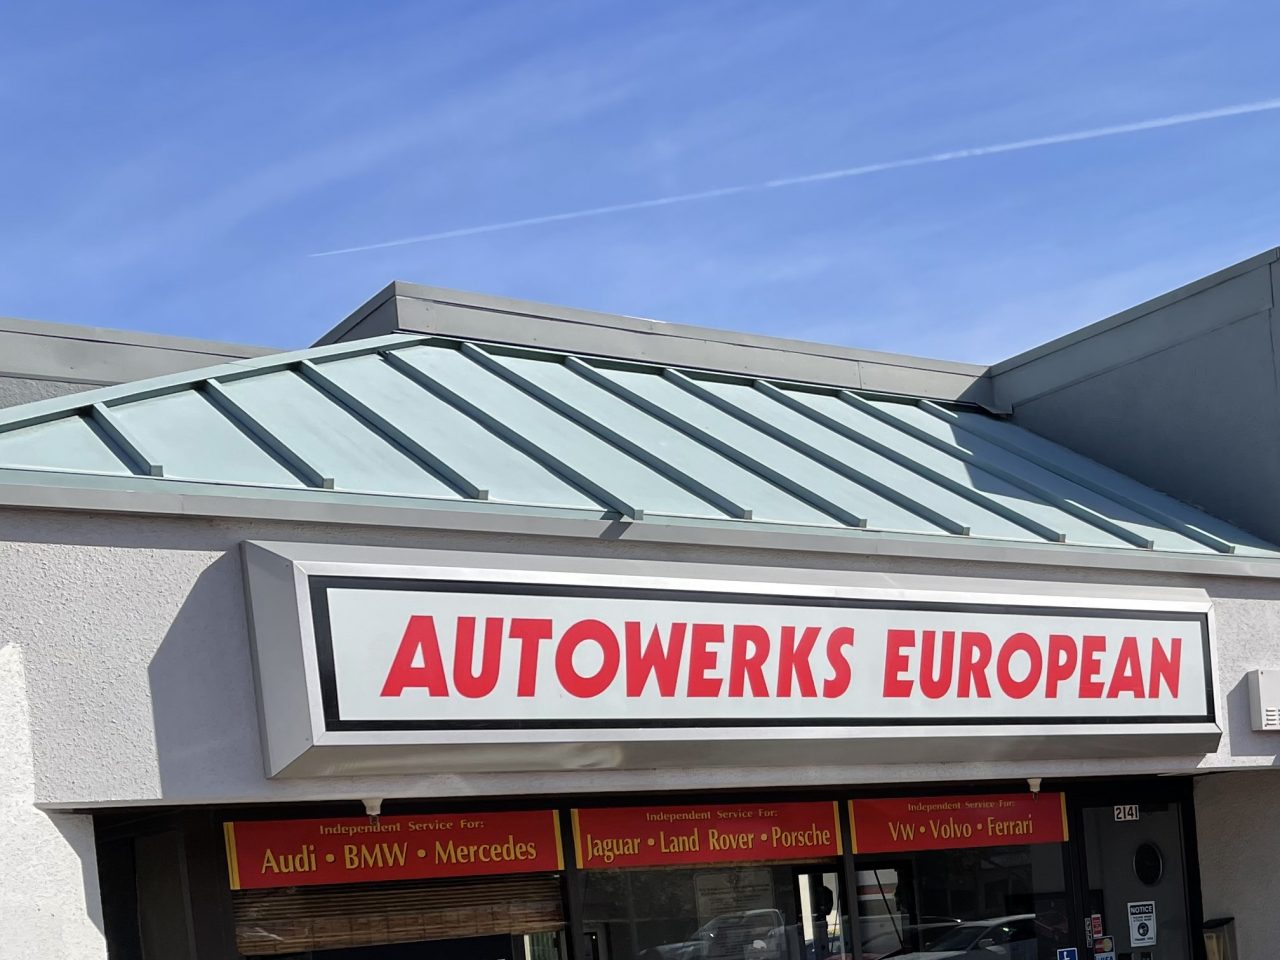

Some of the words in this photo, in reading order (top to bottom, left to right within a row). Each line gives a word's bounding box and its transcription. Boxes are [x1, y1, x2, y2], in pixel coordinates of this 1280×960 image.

[381, 615, 855, 698] AUTOWERKS
[883, 629, 1182, 699] EUROPEAN
[646, 810, 711, 823] Independent
[717, 808, 753, 820] Service
[758, 807, 778, 818] For:
[908, 802, 961, 813] Independent
[965, 800, 995, 810] Service
[1115, 805, 1138, 820] 2141
[319, 821, 402, 836] Independent
[408, 819, 453, 832] Service
[460, 818, 485, 830] For:
[929, 816, 972, 839] Volvo
[987, 813, 1033, 837] Ferrari
[587, 833, 641, 863] Jaguar
[660, 827, 699, 853] Land
[709, 828, 754, 850] Rover
[771, 823, 831, 848] Porsche
[260, 844, 317, 874] Audi
[344, 842, 408, 869] BMW
[435, 834, 537, 865] Mercedes
[1130, 905, 1153, 914] NOTICE
